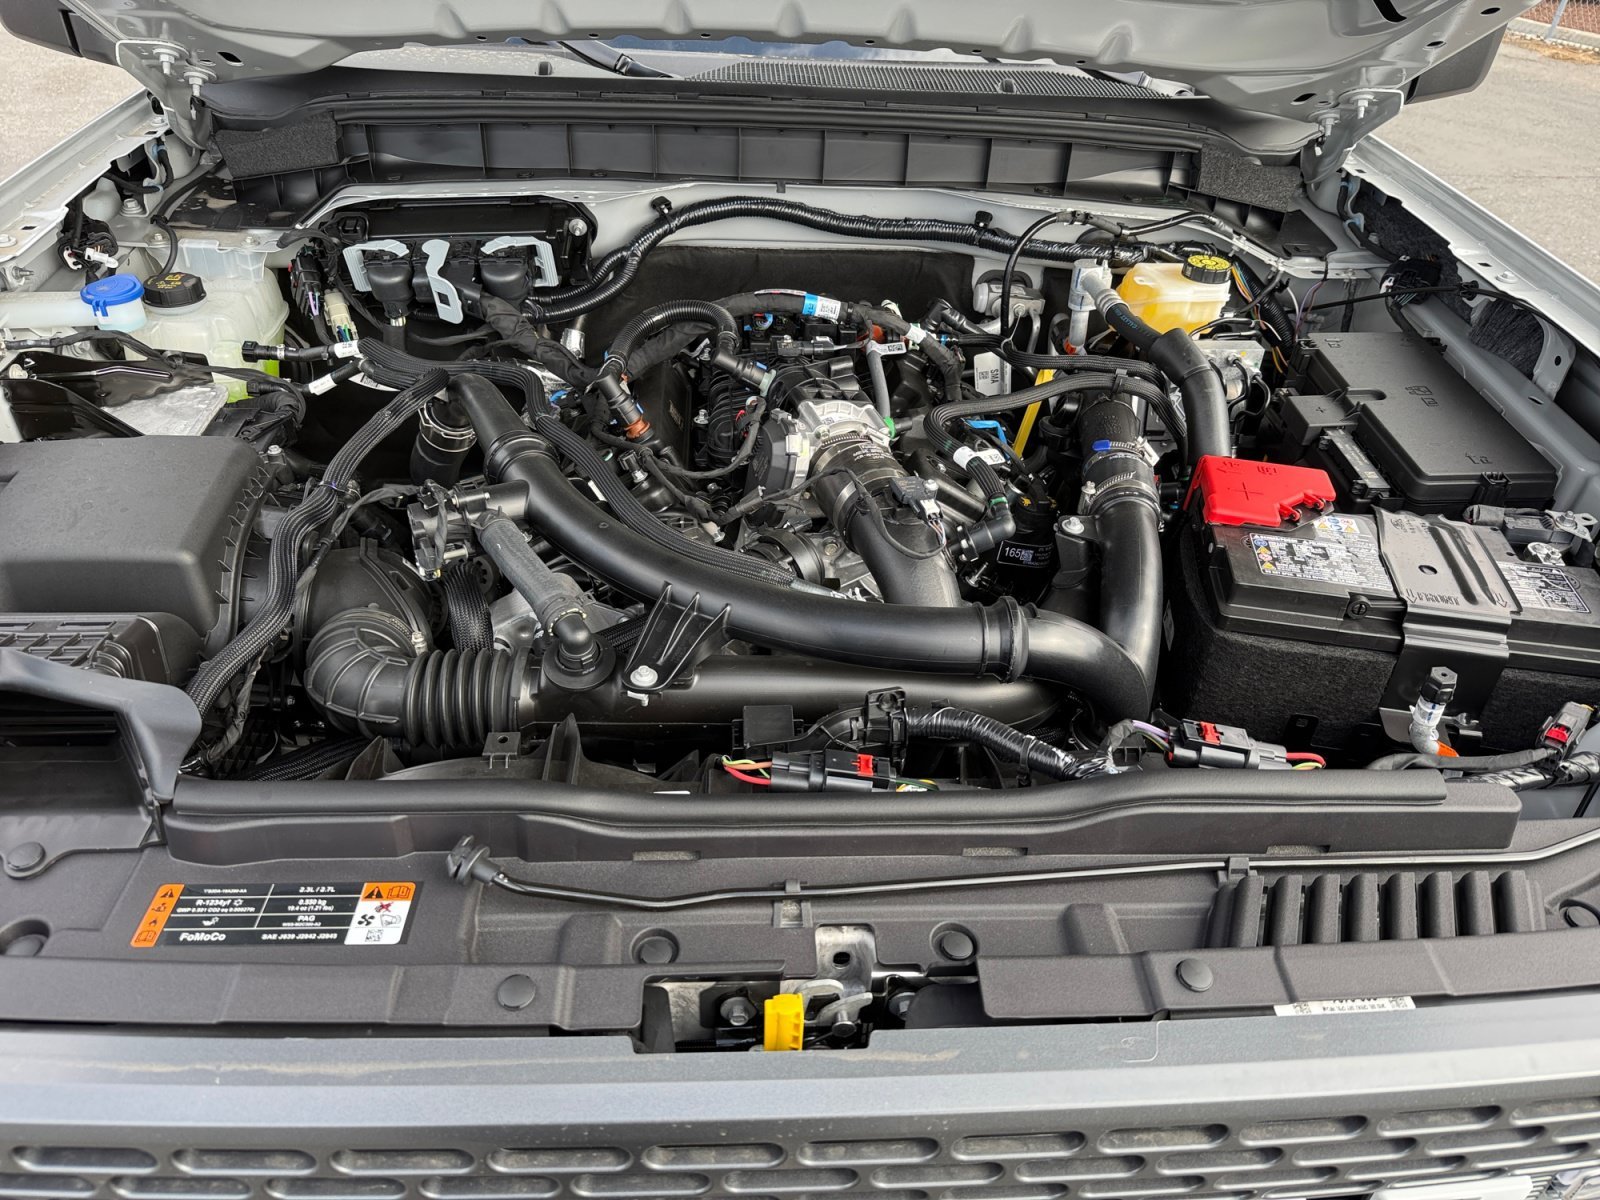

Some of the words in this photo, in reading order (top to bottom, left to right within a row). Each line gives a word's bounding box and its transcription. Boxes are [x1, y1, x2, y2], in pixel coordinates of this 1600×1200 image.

[990, 368, 999, 384] SMA
[1005, 546, 1021, 558] 165
[195, 899, 232, 907] R-1234yf
[179, 932, 226, 941] FoMoCo
